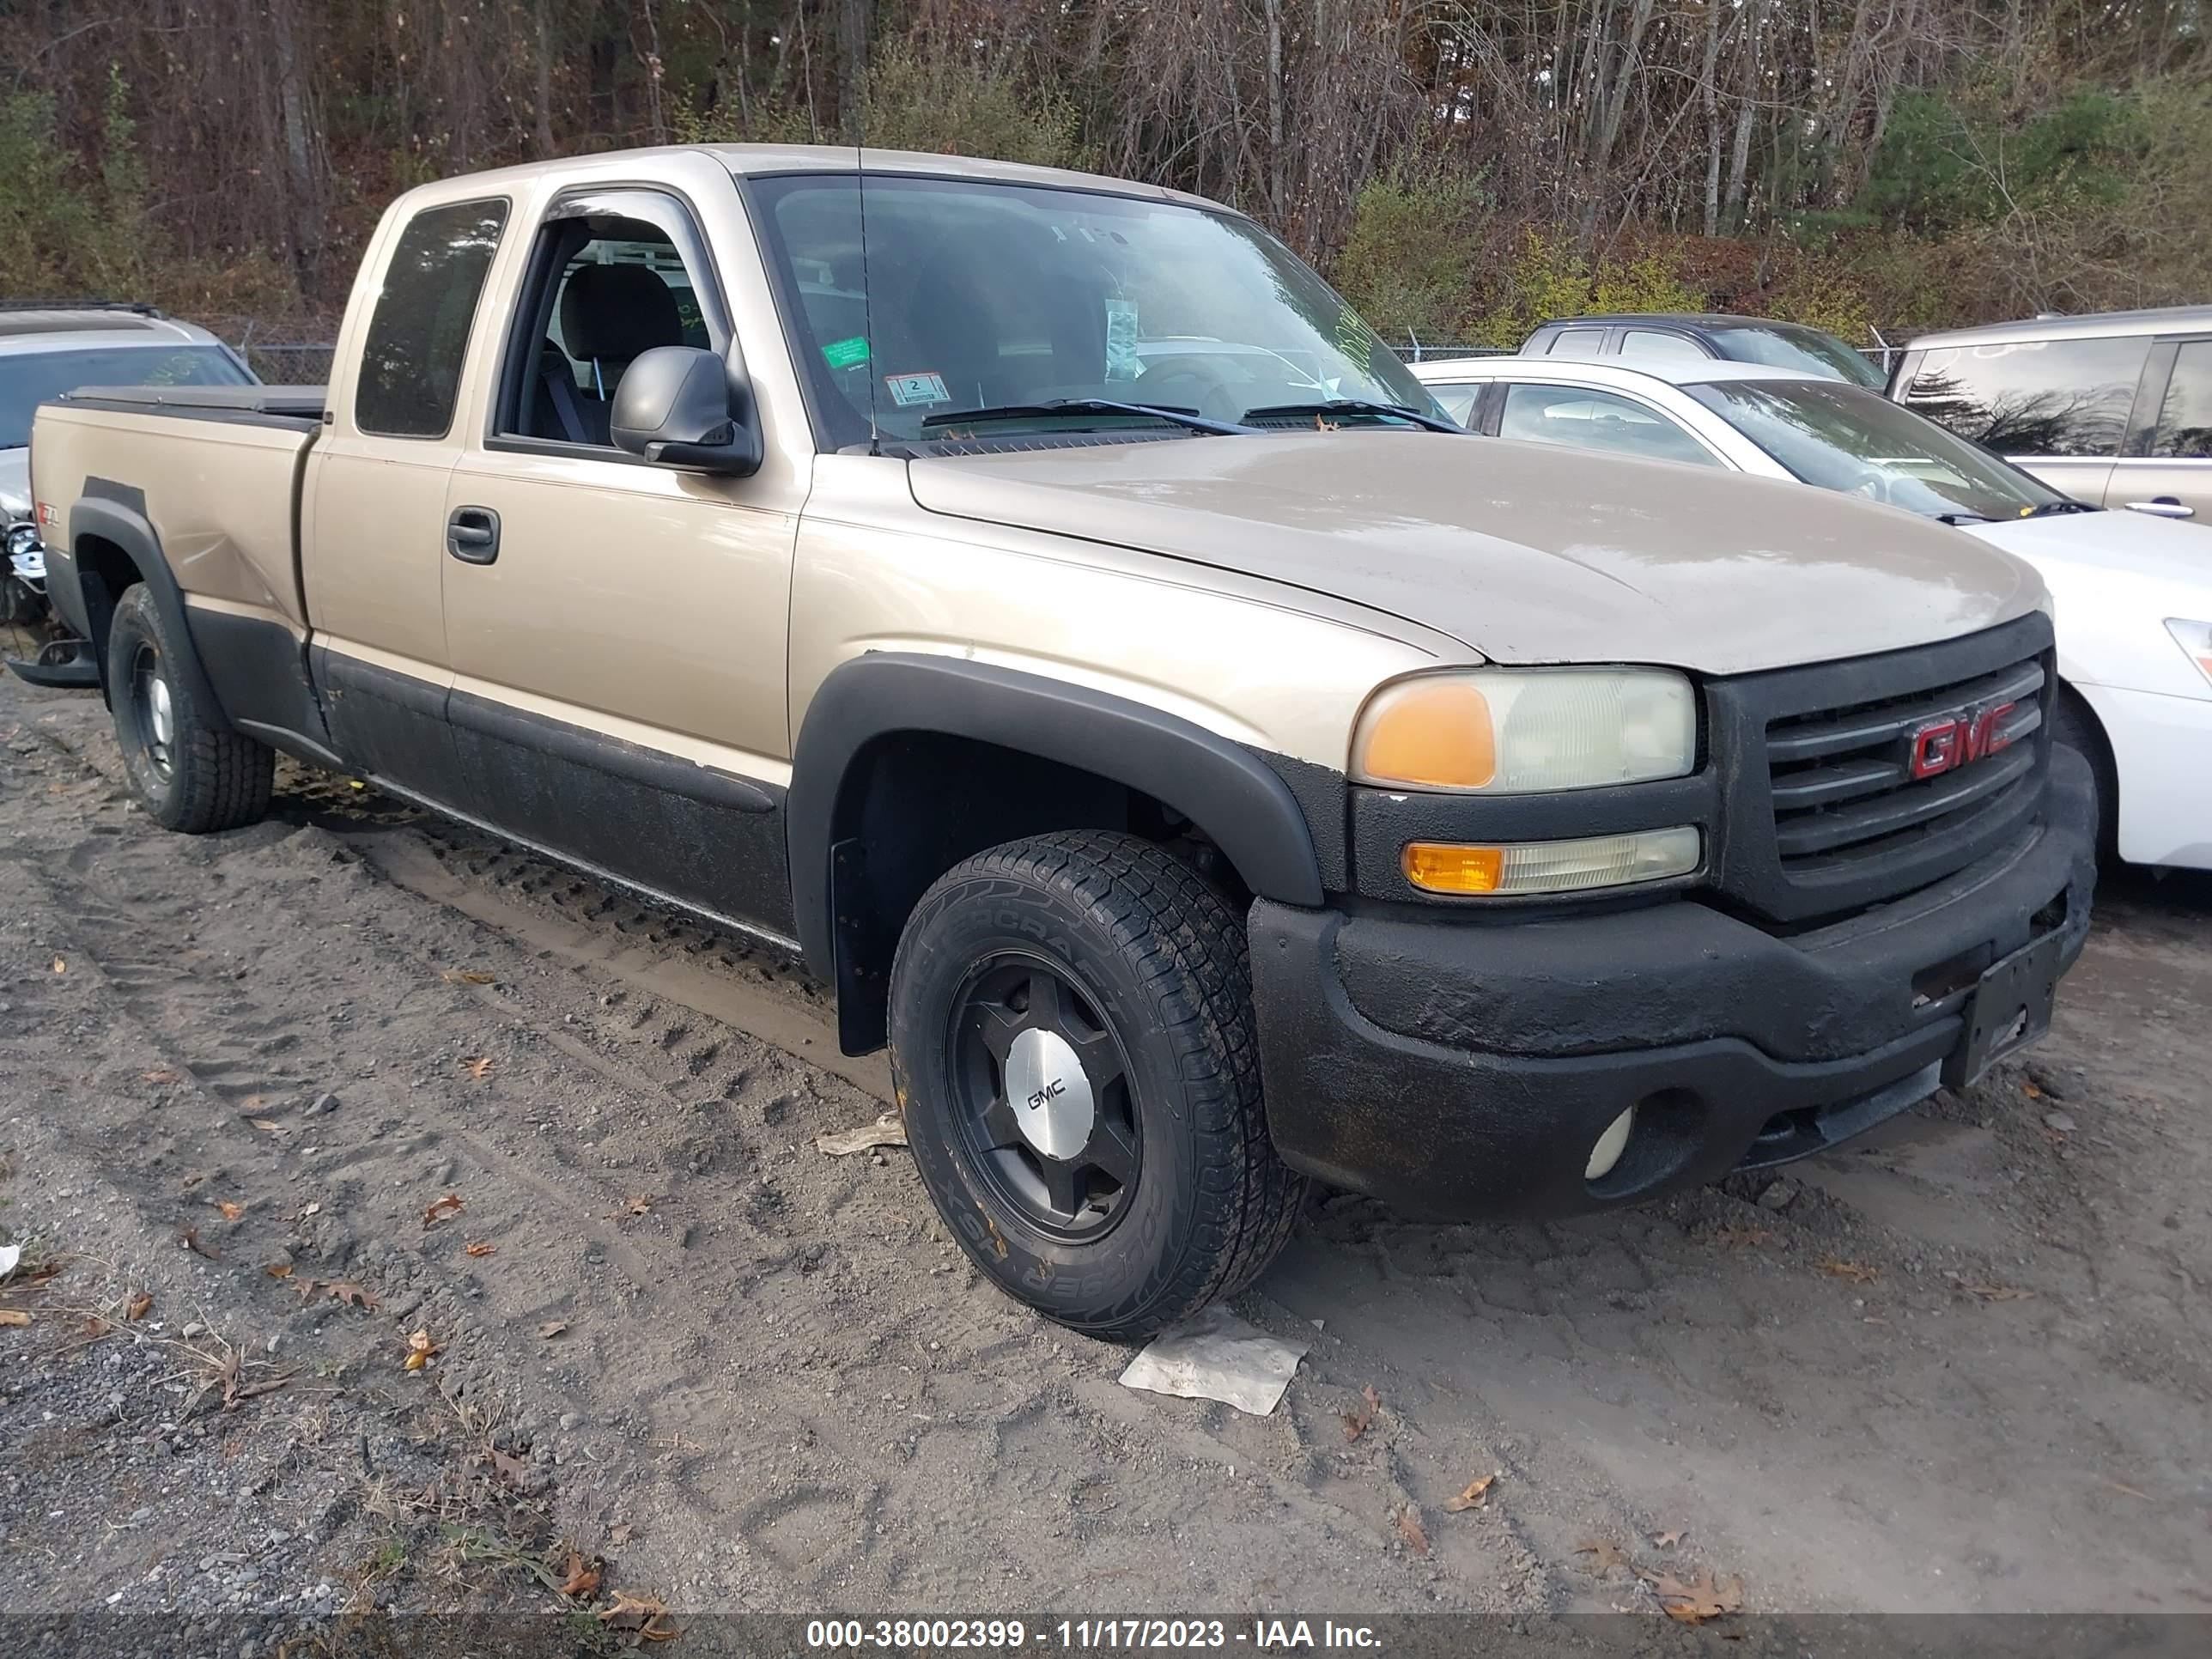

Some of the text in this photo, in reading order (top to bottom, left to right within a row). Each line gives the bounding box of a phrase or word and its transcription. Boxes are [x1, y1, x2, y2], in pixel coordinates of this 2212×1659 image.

[910, 380, 921, 391] 2
[1910, 700, 2015, 780] GMC
[910, 908, 1130, 1024] ASTERCRAFT
[1027, 1077, 1066, 1111] GMC
[935, 1177, 1009, 1264] HSX
[1022, 1179, 1164, 1299] COURSER
